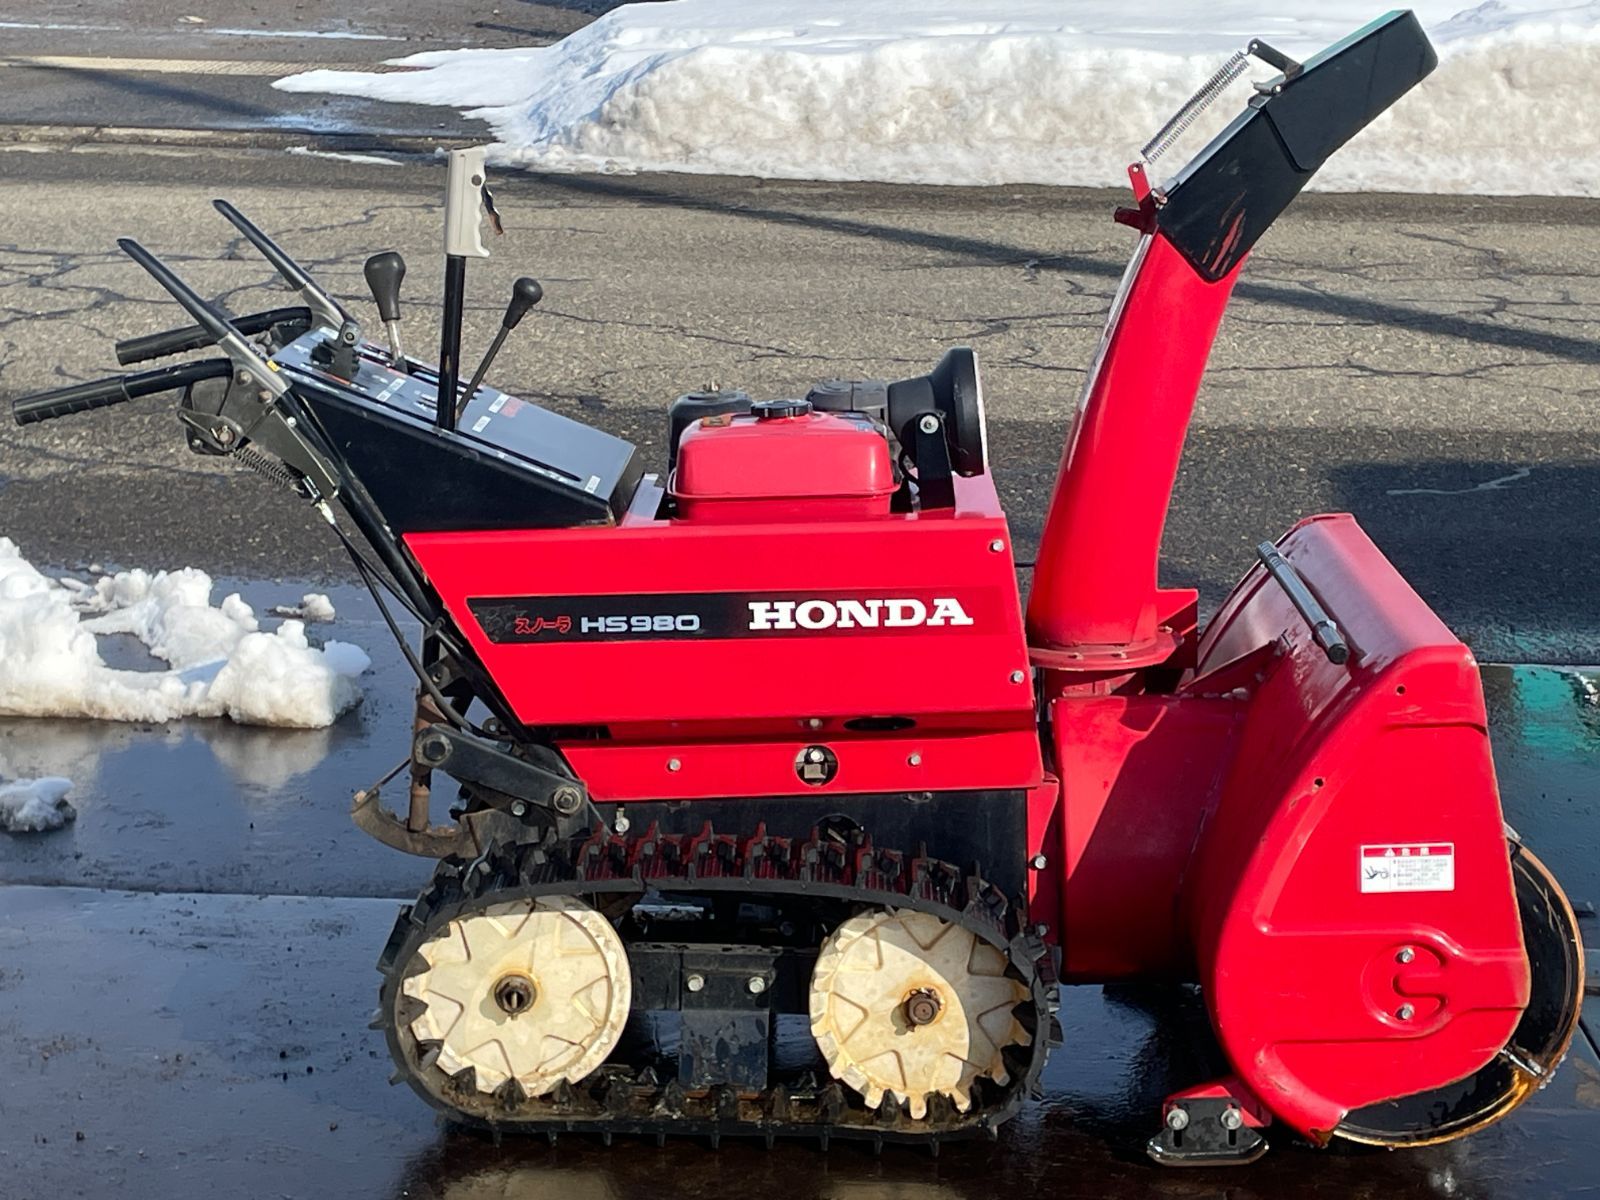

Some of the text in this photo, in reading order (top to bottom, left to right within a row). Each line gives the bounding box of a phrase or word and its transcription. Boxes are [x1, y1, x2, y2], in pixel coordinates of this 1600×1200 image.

[514, 614, 701, 635] スノーラ HS980
[748, 598, 975, 630] HONDA
